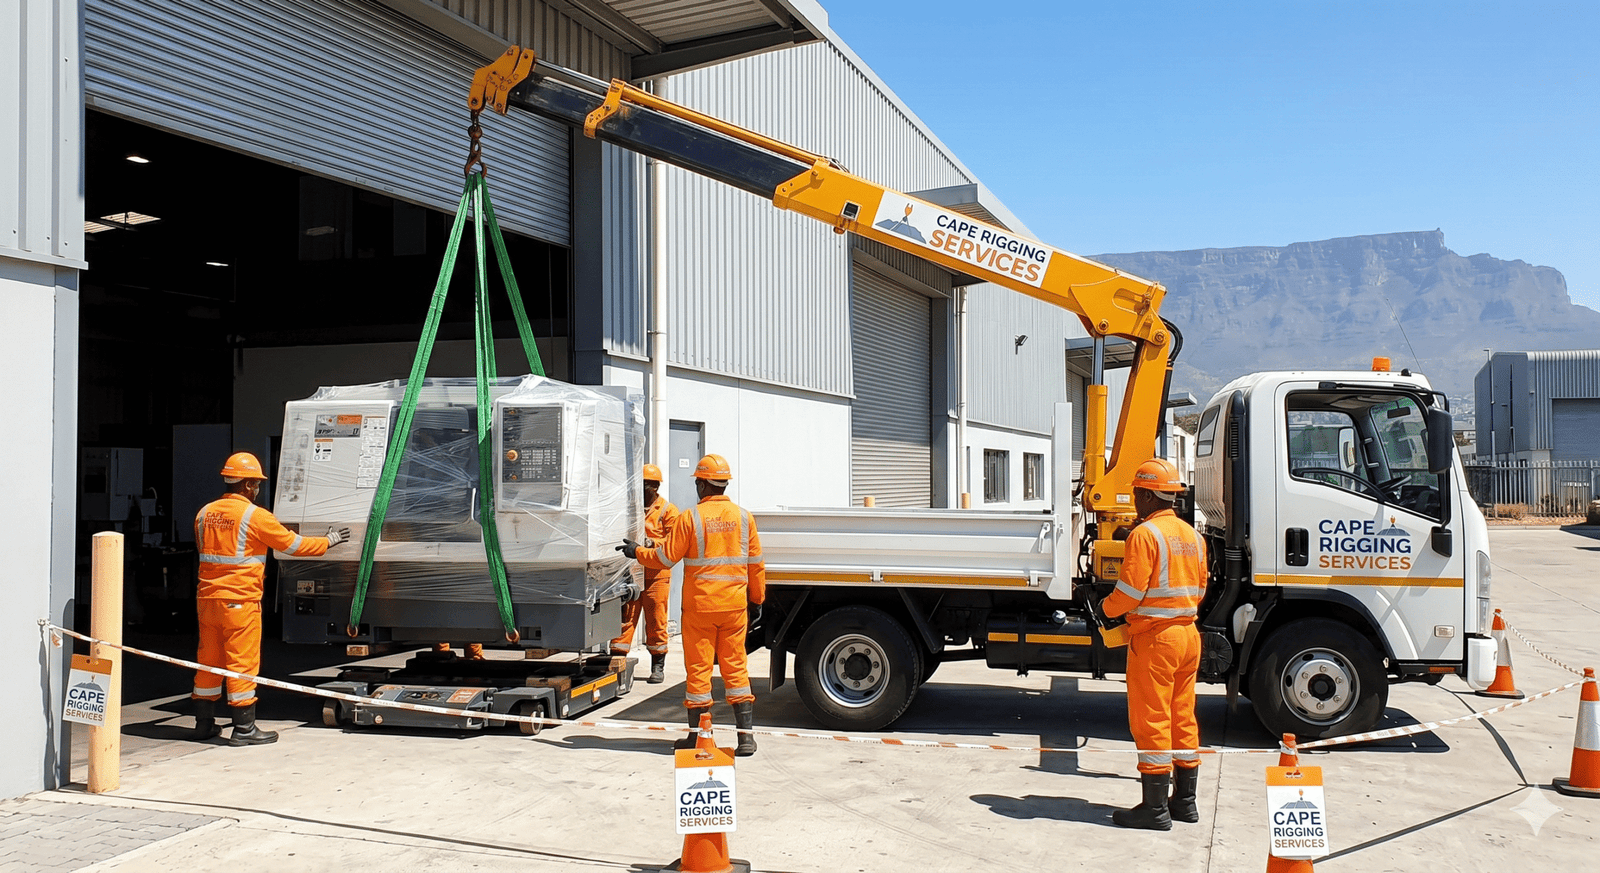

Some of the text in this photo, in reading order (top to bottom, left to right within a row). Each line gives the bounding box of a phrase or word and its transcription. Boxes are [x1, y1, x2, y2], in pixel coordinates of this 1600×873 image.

[936, 214, 1047, 263] CAPE RIGGING
[928, 229, 1041, 282] SERVICES
[1318, 519, 1375, 536] CAPE
[1319, 536, 1412, 554] RIGGING
[1318, 555, 1412, 570] SERVICES
[69, 688, 105, 704] CAPE
[67, 699, 104, 713] RIGGING
[65, 708, 103, 722] SERVICES
[680, 790, 731, 805] CAPE
[680, 805, 733, 817] RIGGING
[1273, 811, 1322, 826] CAPE
[679, 816, 734, 828] SERVICES
[1273, 827, 1324, 837] RIGGING
[1274, 839, 1325, 848] SERVICES
